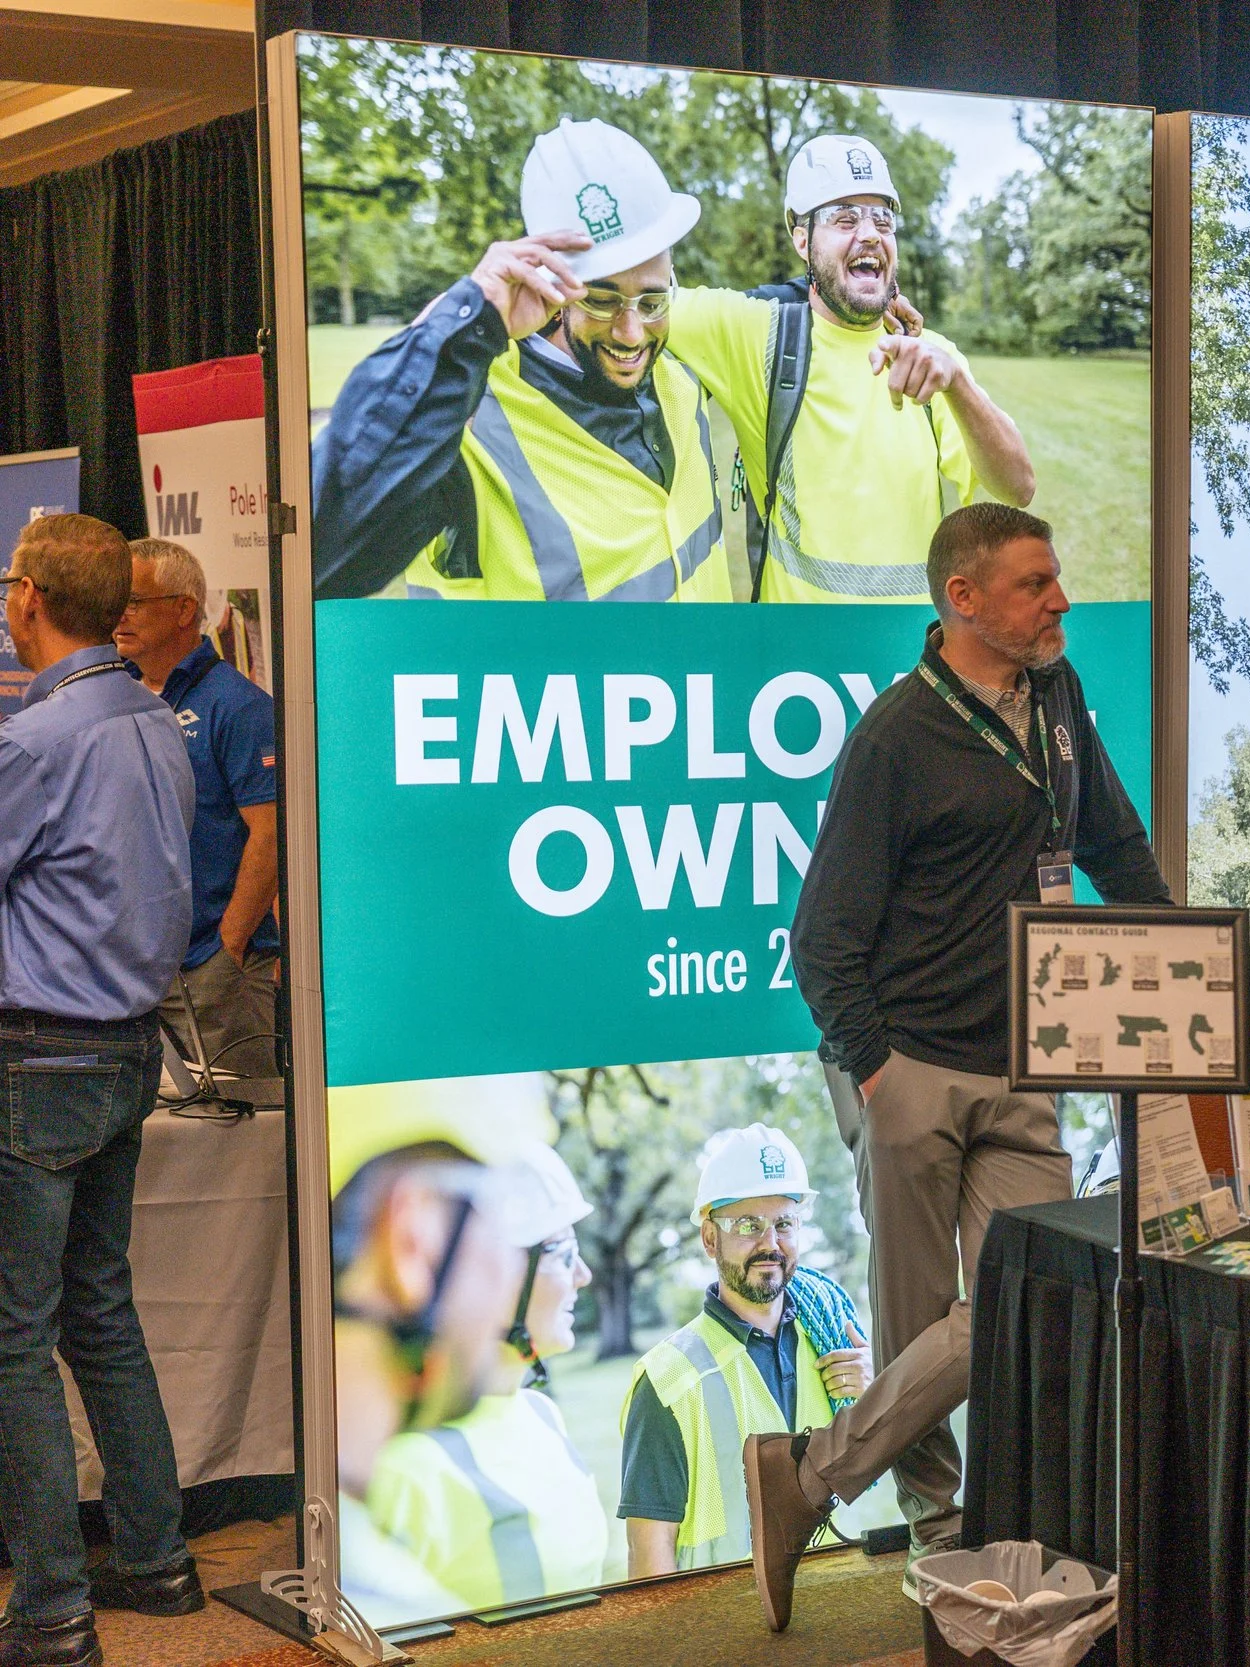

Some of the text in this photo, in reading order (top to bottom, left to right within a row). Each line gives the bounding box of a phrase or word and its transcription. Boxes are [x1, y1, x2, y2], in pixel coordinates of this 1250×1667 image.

[593, 228, 624, 244] WRIGHT
[230, 483, 257, 516] Pole
[1030, 926, 1148, 936] REGIONAL CONTACTS GUIDE
[647, 937, 747, 997] since
